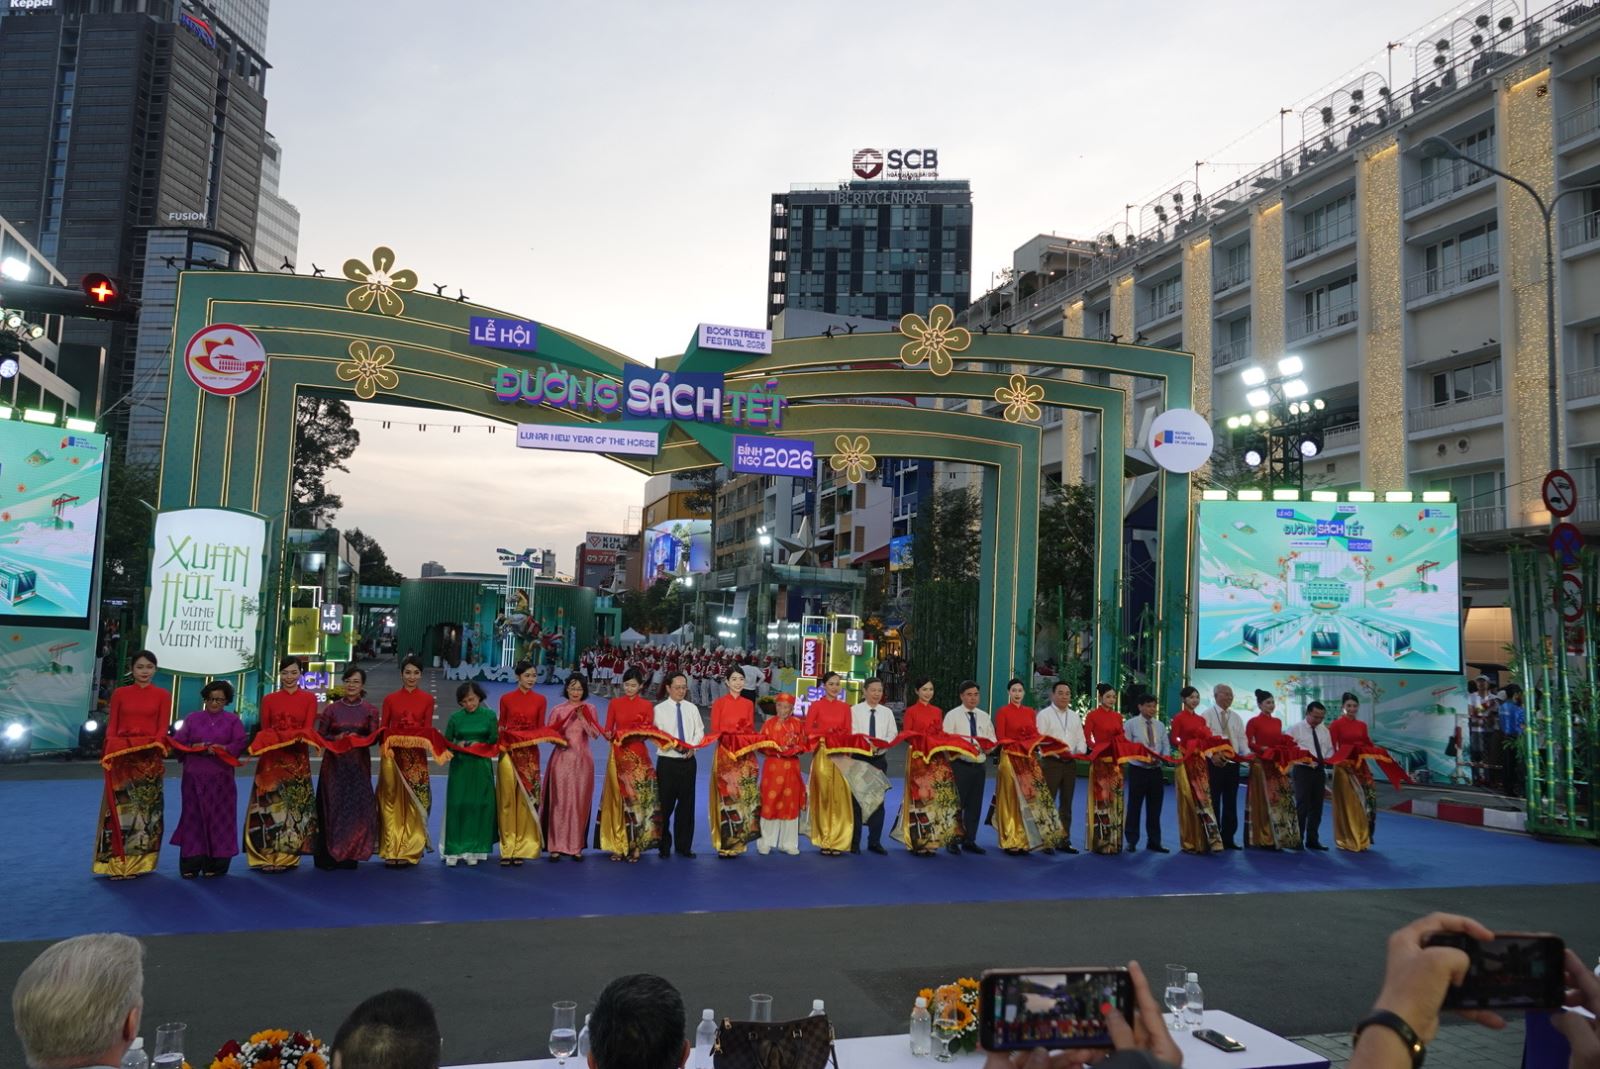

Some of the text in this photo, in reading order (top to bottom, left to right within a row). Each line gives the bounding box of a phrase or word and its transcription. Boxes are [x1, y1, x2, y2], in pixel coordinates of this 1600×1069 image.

[887, 149, 938, 169] SCB
[828, 192, 929, 204] LIBERTY CENTRAL
[169, 212, 206, 220] FUSION
[475, 319, 530, 347] LỄ HỘI
[706, 326, 766, 340] BOOK STREET
[706, 336, 766, 350] FESTIVAL 2026
[492, 363, 787, 428] ĐƯỜNG SÁCH TẾT
[520, 432, 655, 448] LUNAR NEW YEAR OF THE HORSE
[737, 443, 762, 456] BÍNH
[738, 456, 761, 468] NGỌ
[763, 447, 813, 470] 2026
[159, 535, 250, 587] XUÂN
[161, 572, 214, 631] HỘI
